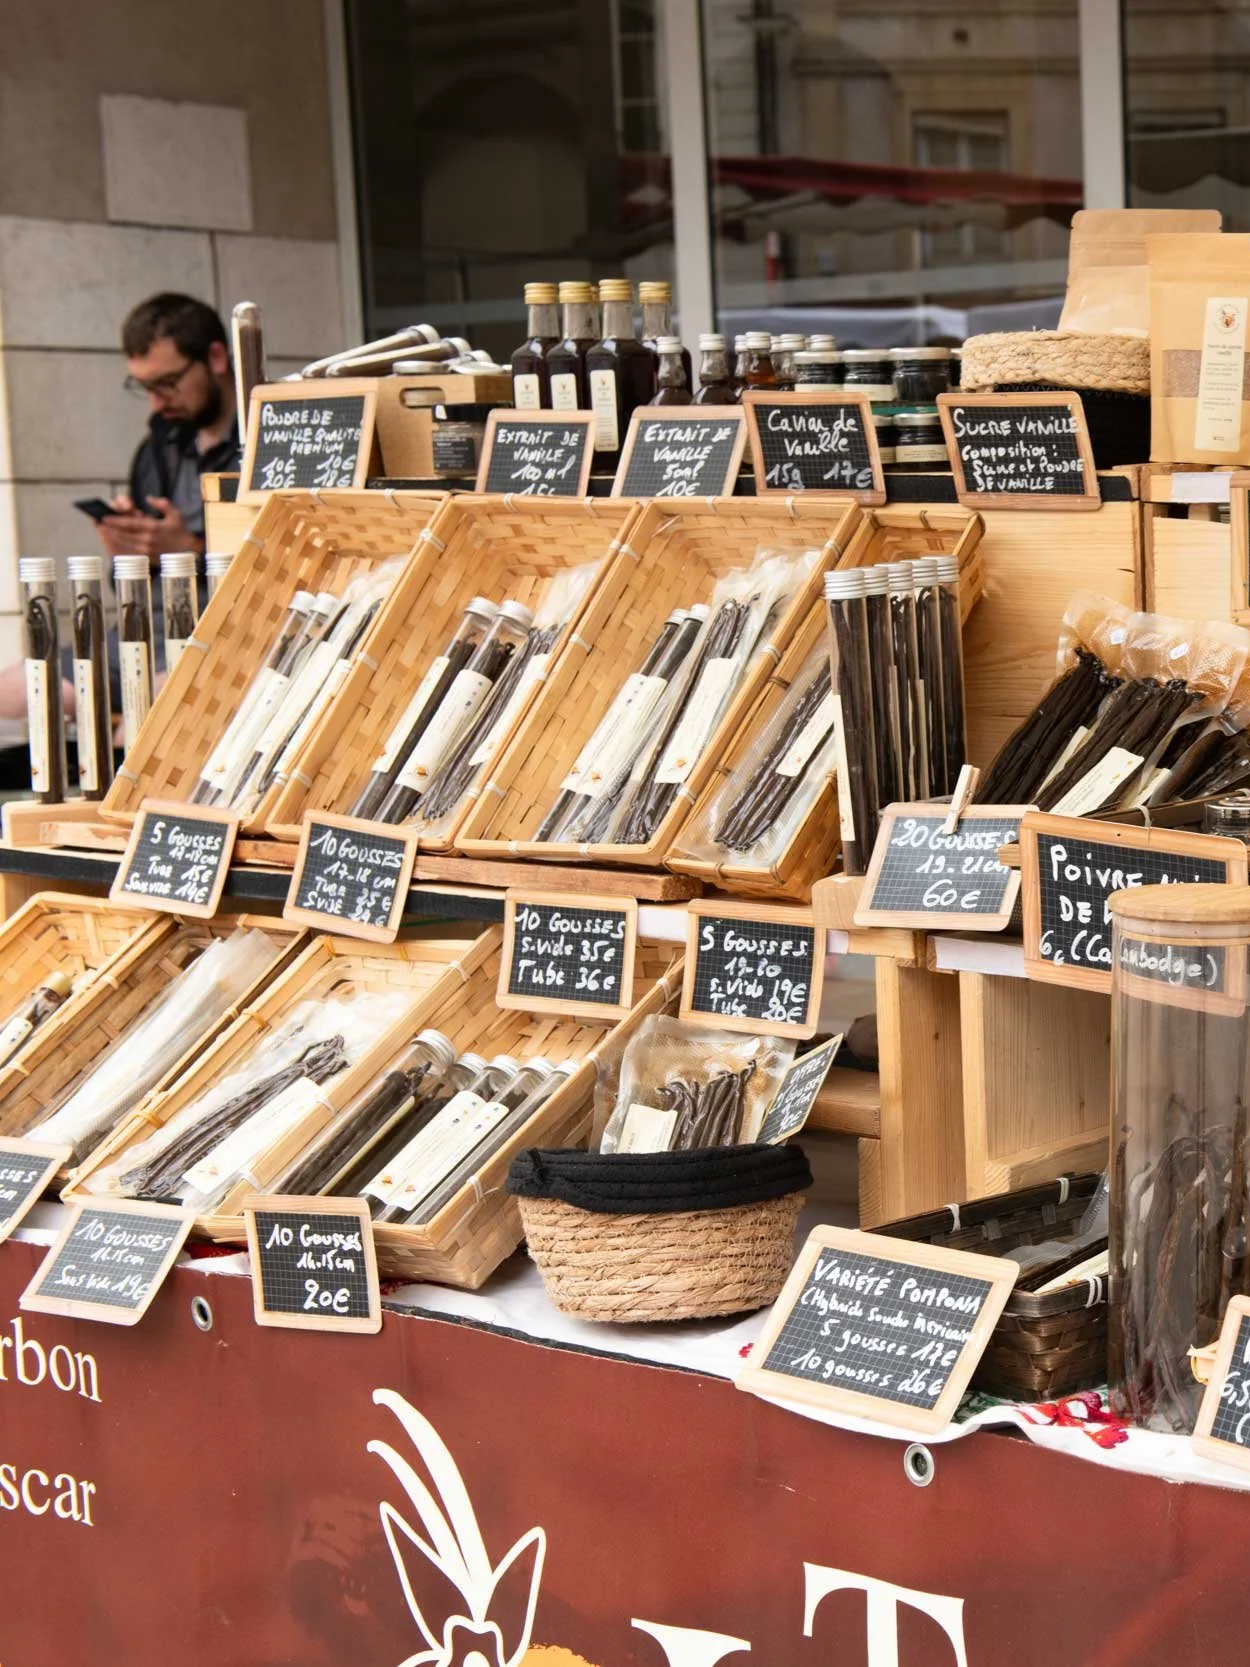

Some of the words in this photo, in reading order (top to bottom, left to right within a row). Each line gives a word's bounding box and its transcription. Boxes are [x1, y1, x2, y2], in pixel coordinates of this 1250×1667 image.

[833, 408, 859, 432] de
[560, 431, 580, 447] DE
[712, 427, 733, 443] DE
[150, 821, 166, 844] 5
[310, 829, 337, 856] 10
[891, 818, 929, 848] 20
[514, 907, 541, 931] 10
[1059, 895, 1093, 924] DE
[700, 925, 715, 951] 5
[75, 1218, 105, 1241] 10
[265, 1223, 294, 1249] 10
[303, 1279, 351, 1313] 20€
[820, 1319, 840, 1336] 5
[791, 1348, 821, 1371] 10
